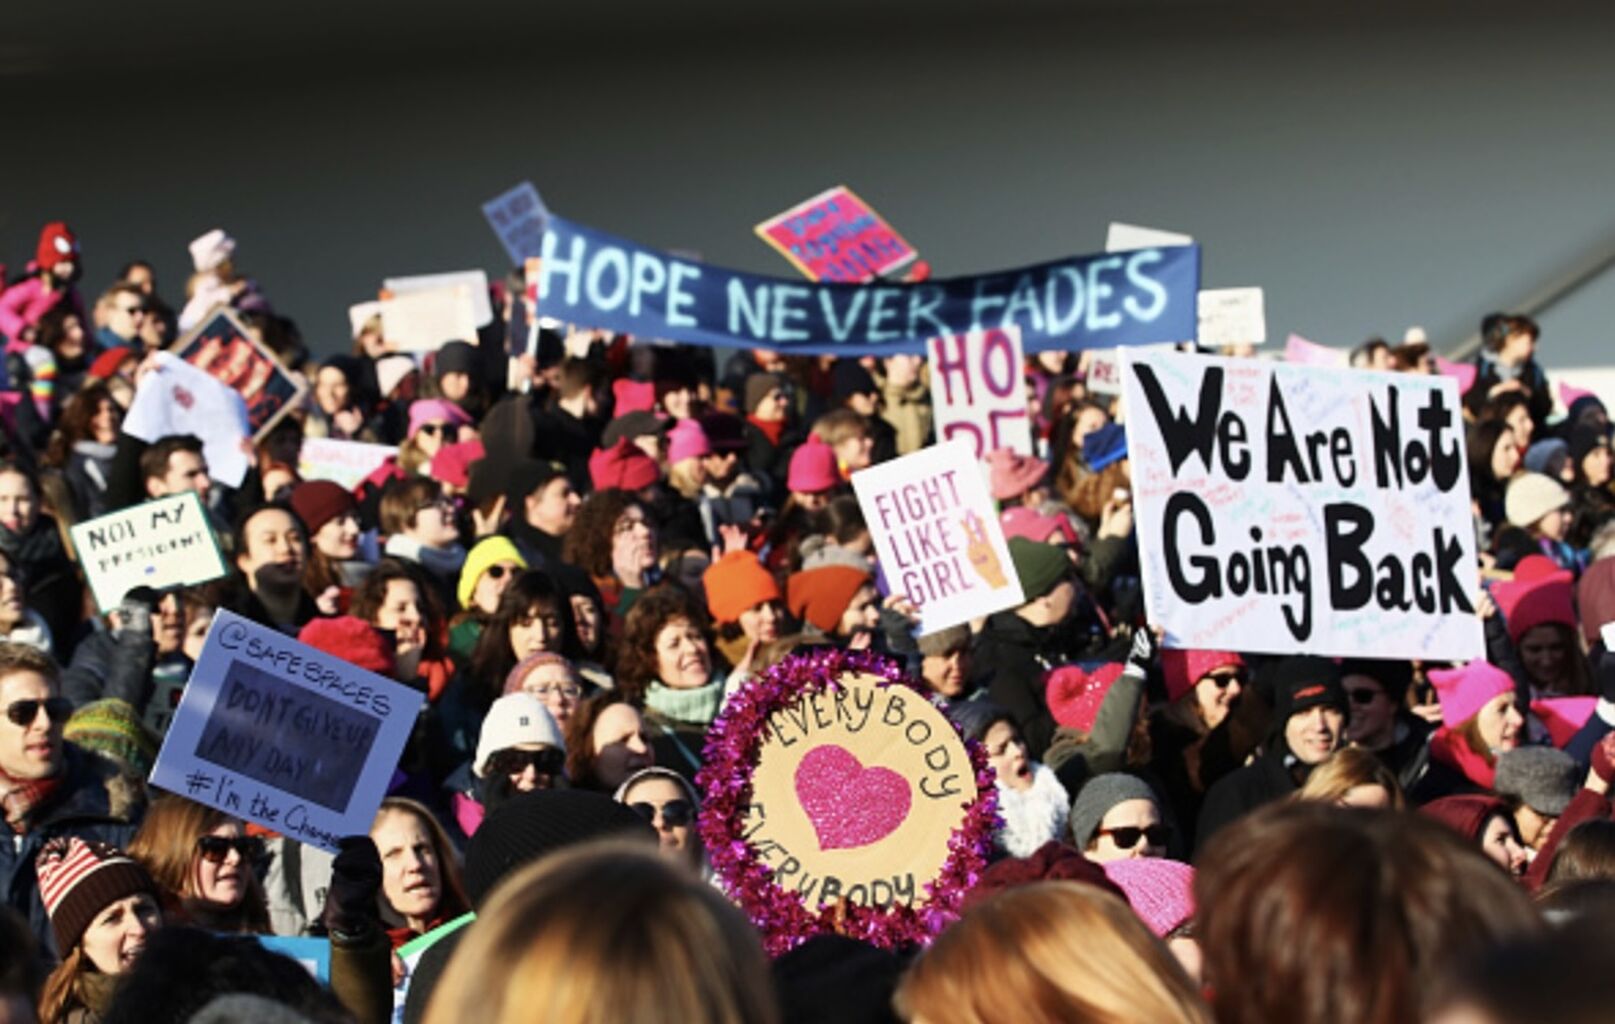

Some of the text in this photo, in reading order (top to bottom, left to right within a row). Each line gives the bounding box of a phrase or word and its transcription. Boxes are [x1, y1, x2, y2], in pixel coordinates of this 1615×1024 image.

[538, 230, 701, 327] HOPE
[727, 278, 954, 342] NEVER
[970, 249, 1167, 337] FADES
[934, 329, 1016, 406] HO
[1132, 361, 1462, 493] We Are Not
[151, 502, 185, 530] MY
[874, 470, 962, 531] FIGHT
[888, 517, 960, 571] LIKE
[1163, 490, 1312, 642] Going
[1324, 501, 1477, 615] Back
[901, 557, 975, 608] GIRL
[250, 792, 280, 823] the
